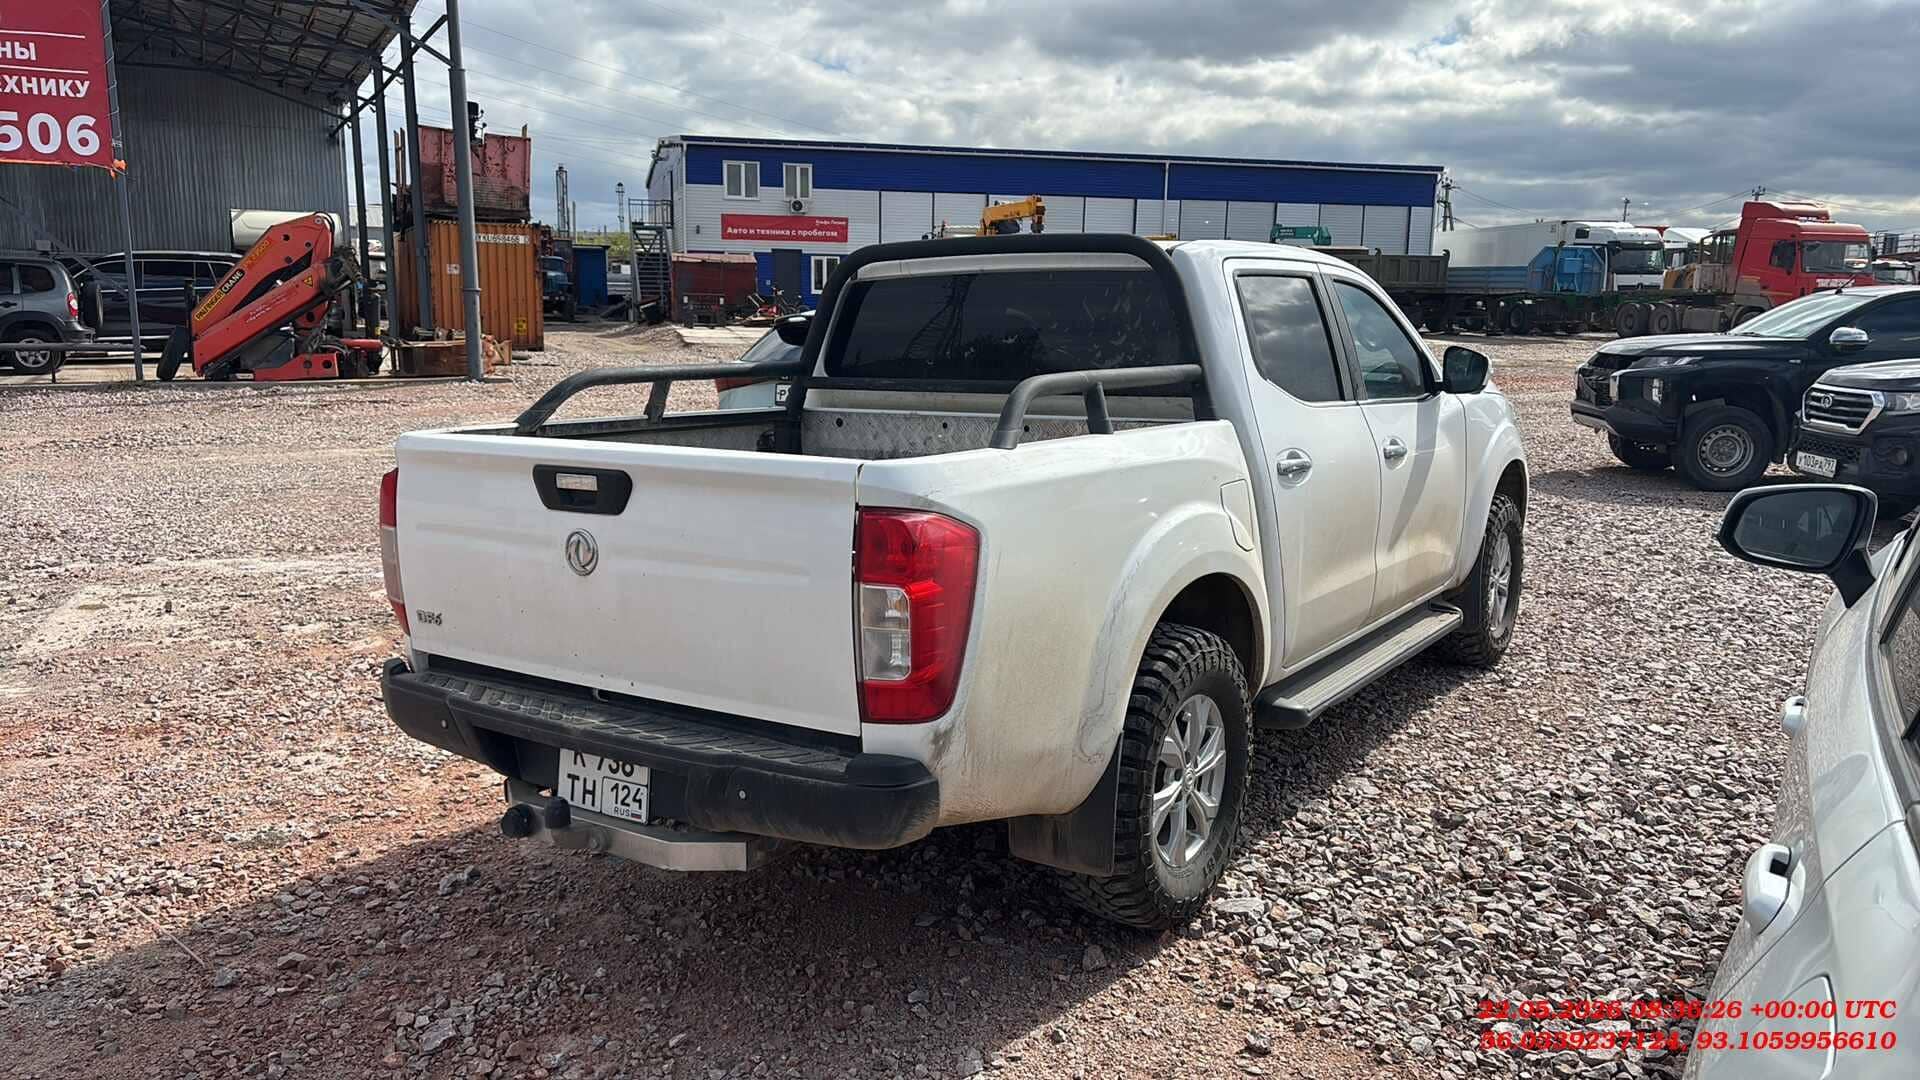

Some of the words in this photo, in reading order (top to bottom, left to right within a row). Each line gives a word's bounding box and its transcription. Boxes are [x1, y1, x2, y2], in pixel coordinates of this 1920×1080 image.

[0, 75, 90, 98] ХНИКУ
[0, 111, 100, 157] 506
[727, 226, 748, 235] Авто
[757, 228, 791, 236] техника
[798, 228, 838, 238] пробегом
[221, 268, 245, 294] CRANE
[610, 782, 643, 810] 124
[614, 806, 630, 817] RUS
